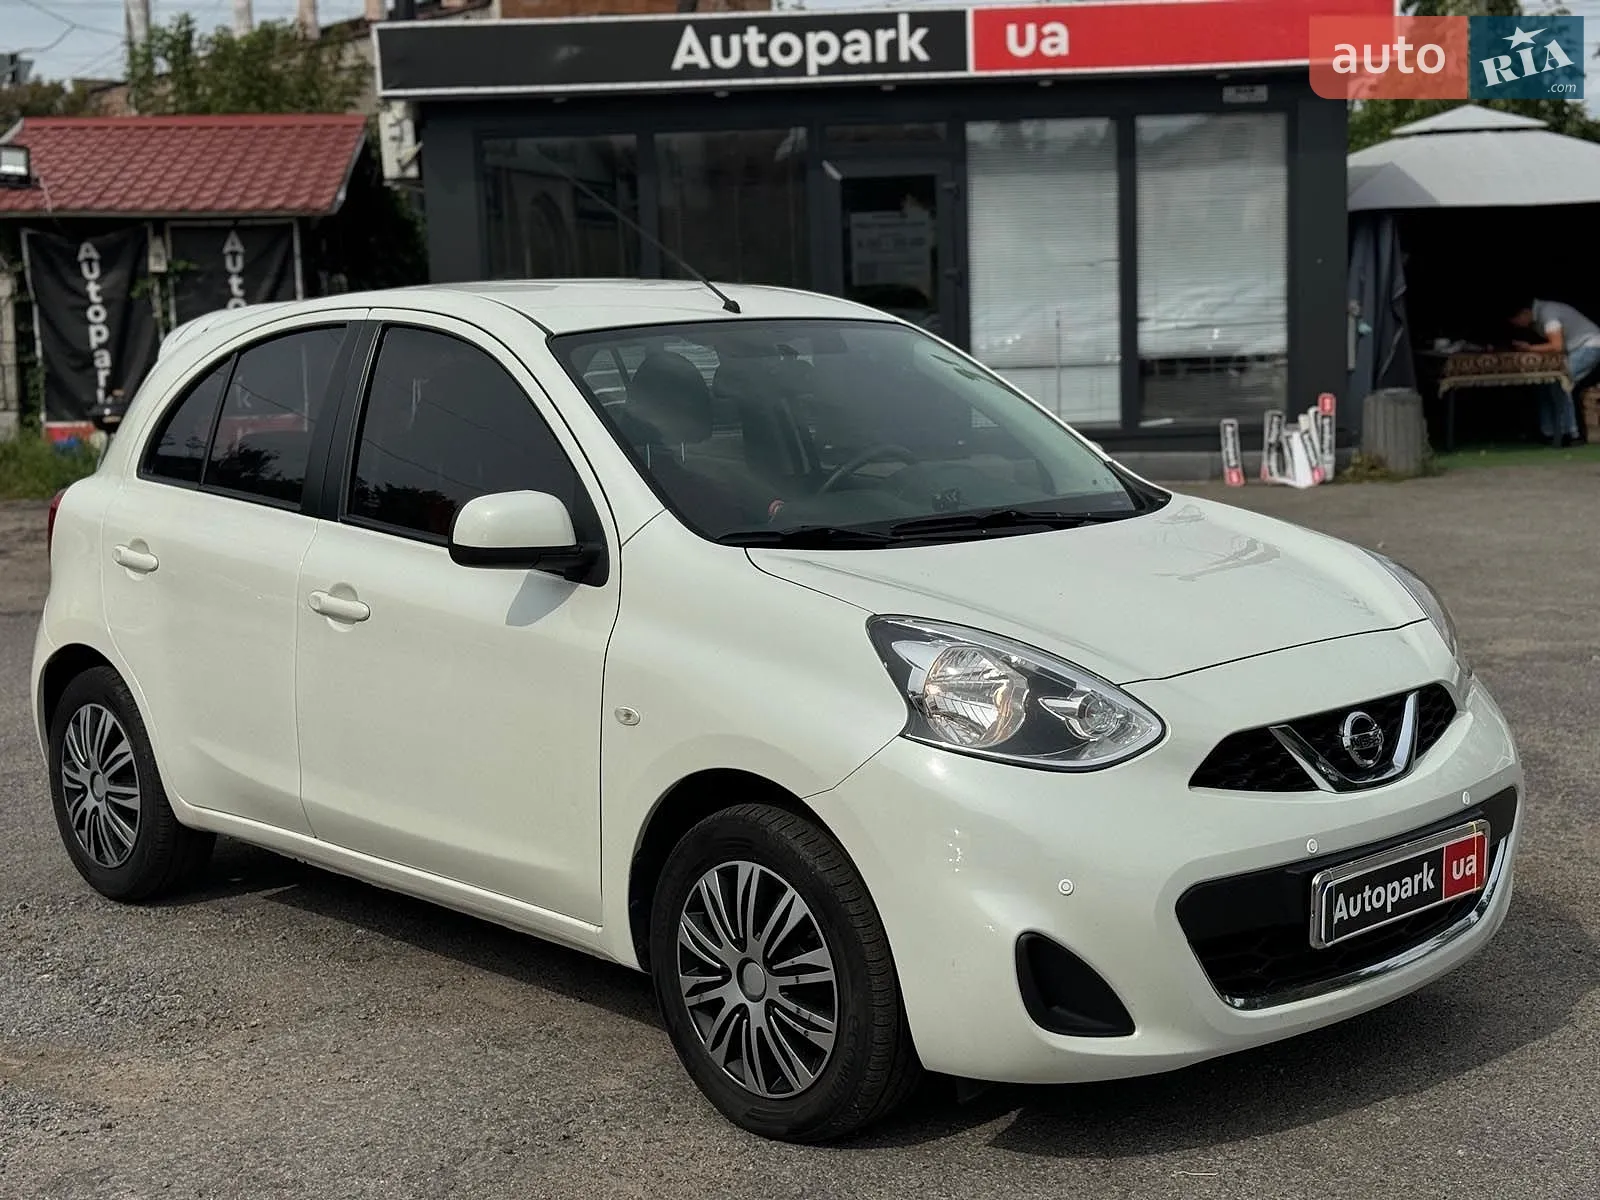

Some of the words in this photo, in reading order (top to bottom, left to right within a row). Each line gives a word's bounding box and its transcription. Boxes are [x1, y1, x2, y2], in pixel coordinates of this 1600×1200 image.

[671, 13, 931, 76] Autopark
[1006, 21, 1069, 57] ua
[1334, 861, 1435, 925] Autopark
[1452, 854, 1476, 880] ua
